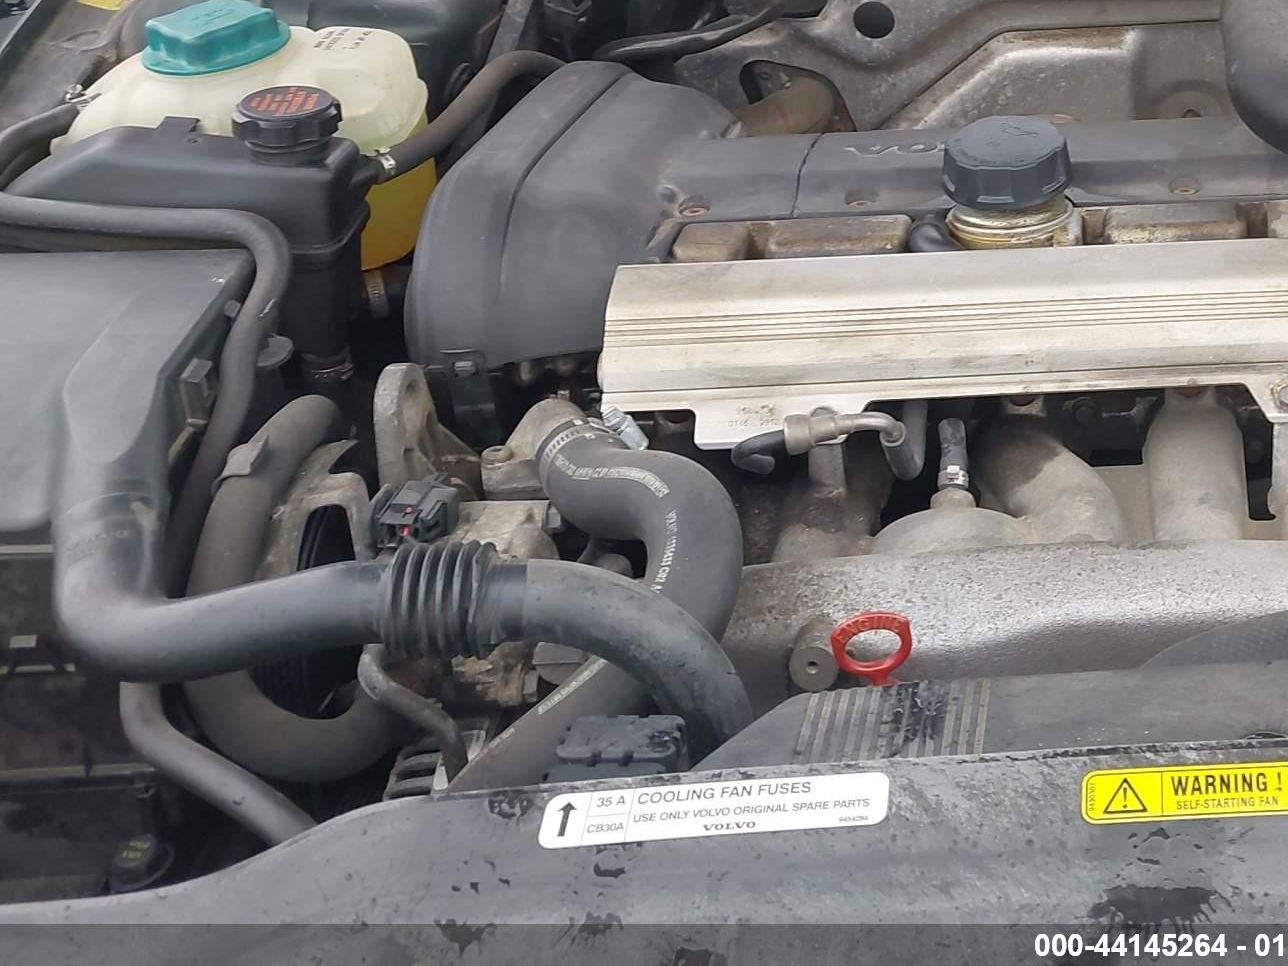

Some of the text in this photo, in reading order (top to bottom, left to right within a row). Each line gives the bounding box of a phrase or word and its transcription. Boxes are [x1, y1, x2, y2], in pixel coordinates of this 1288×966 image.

[1171, 772, 1268, 796] WARNING
[637, 781, 812, 805] COOLING FAN FUSES
[596, 795, 626, 808] 35 A
[1176, 795, 1279, 811] SELF-STARTING FAN
[633, 797, 871, 823] USE ONLY VOLVO ORIGINAL SPARE PARTS
[586, 822, 625, 834] CB30A
[703, 821, 756, 832] VOLVO
